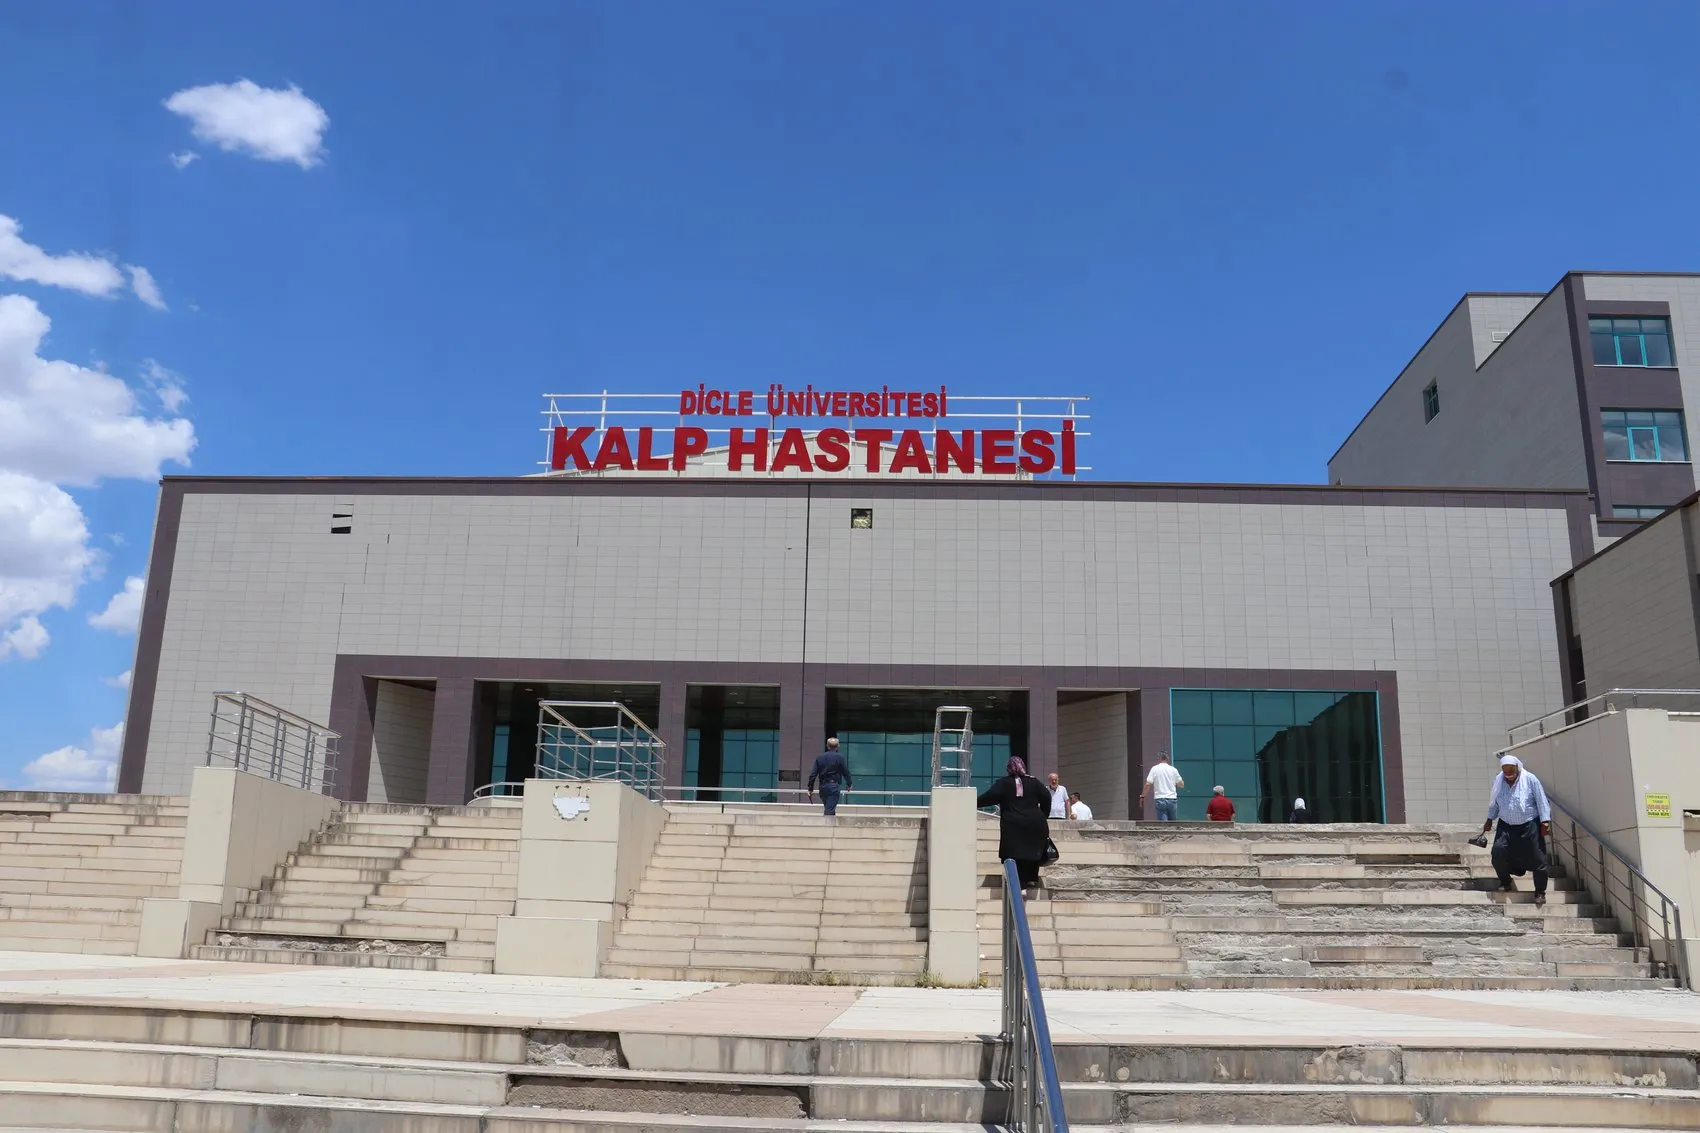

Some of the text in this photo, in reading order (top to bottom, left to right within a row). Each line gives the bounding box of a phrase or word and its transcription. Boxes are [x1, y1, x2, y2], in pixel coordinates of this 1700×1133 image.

[680, 384, 947, 417] DİCLE ÜNİVERSİTESİ
[552, 419, 1076, 475] KALP HASTANESİ
